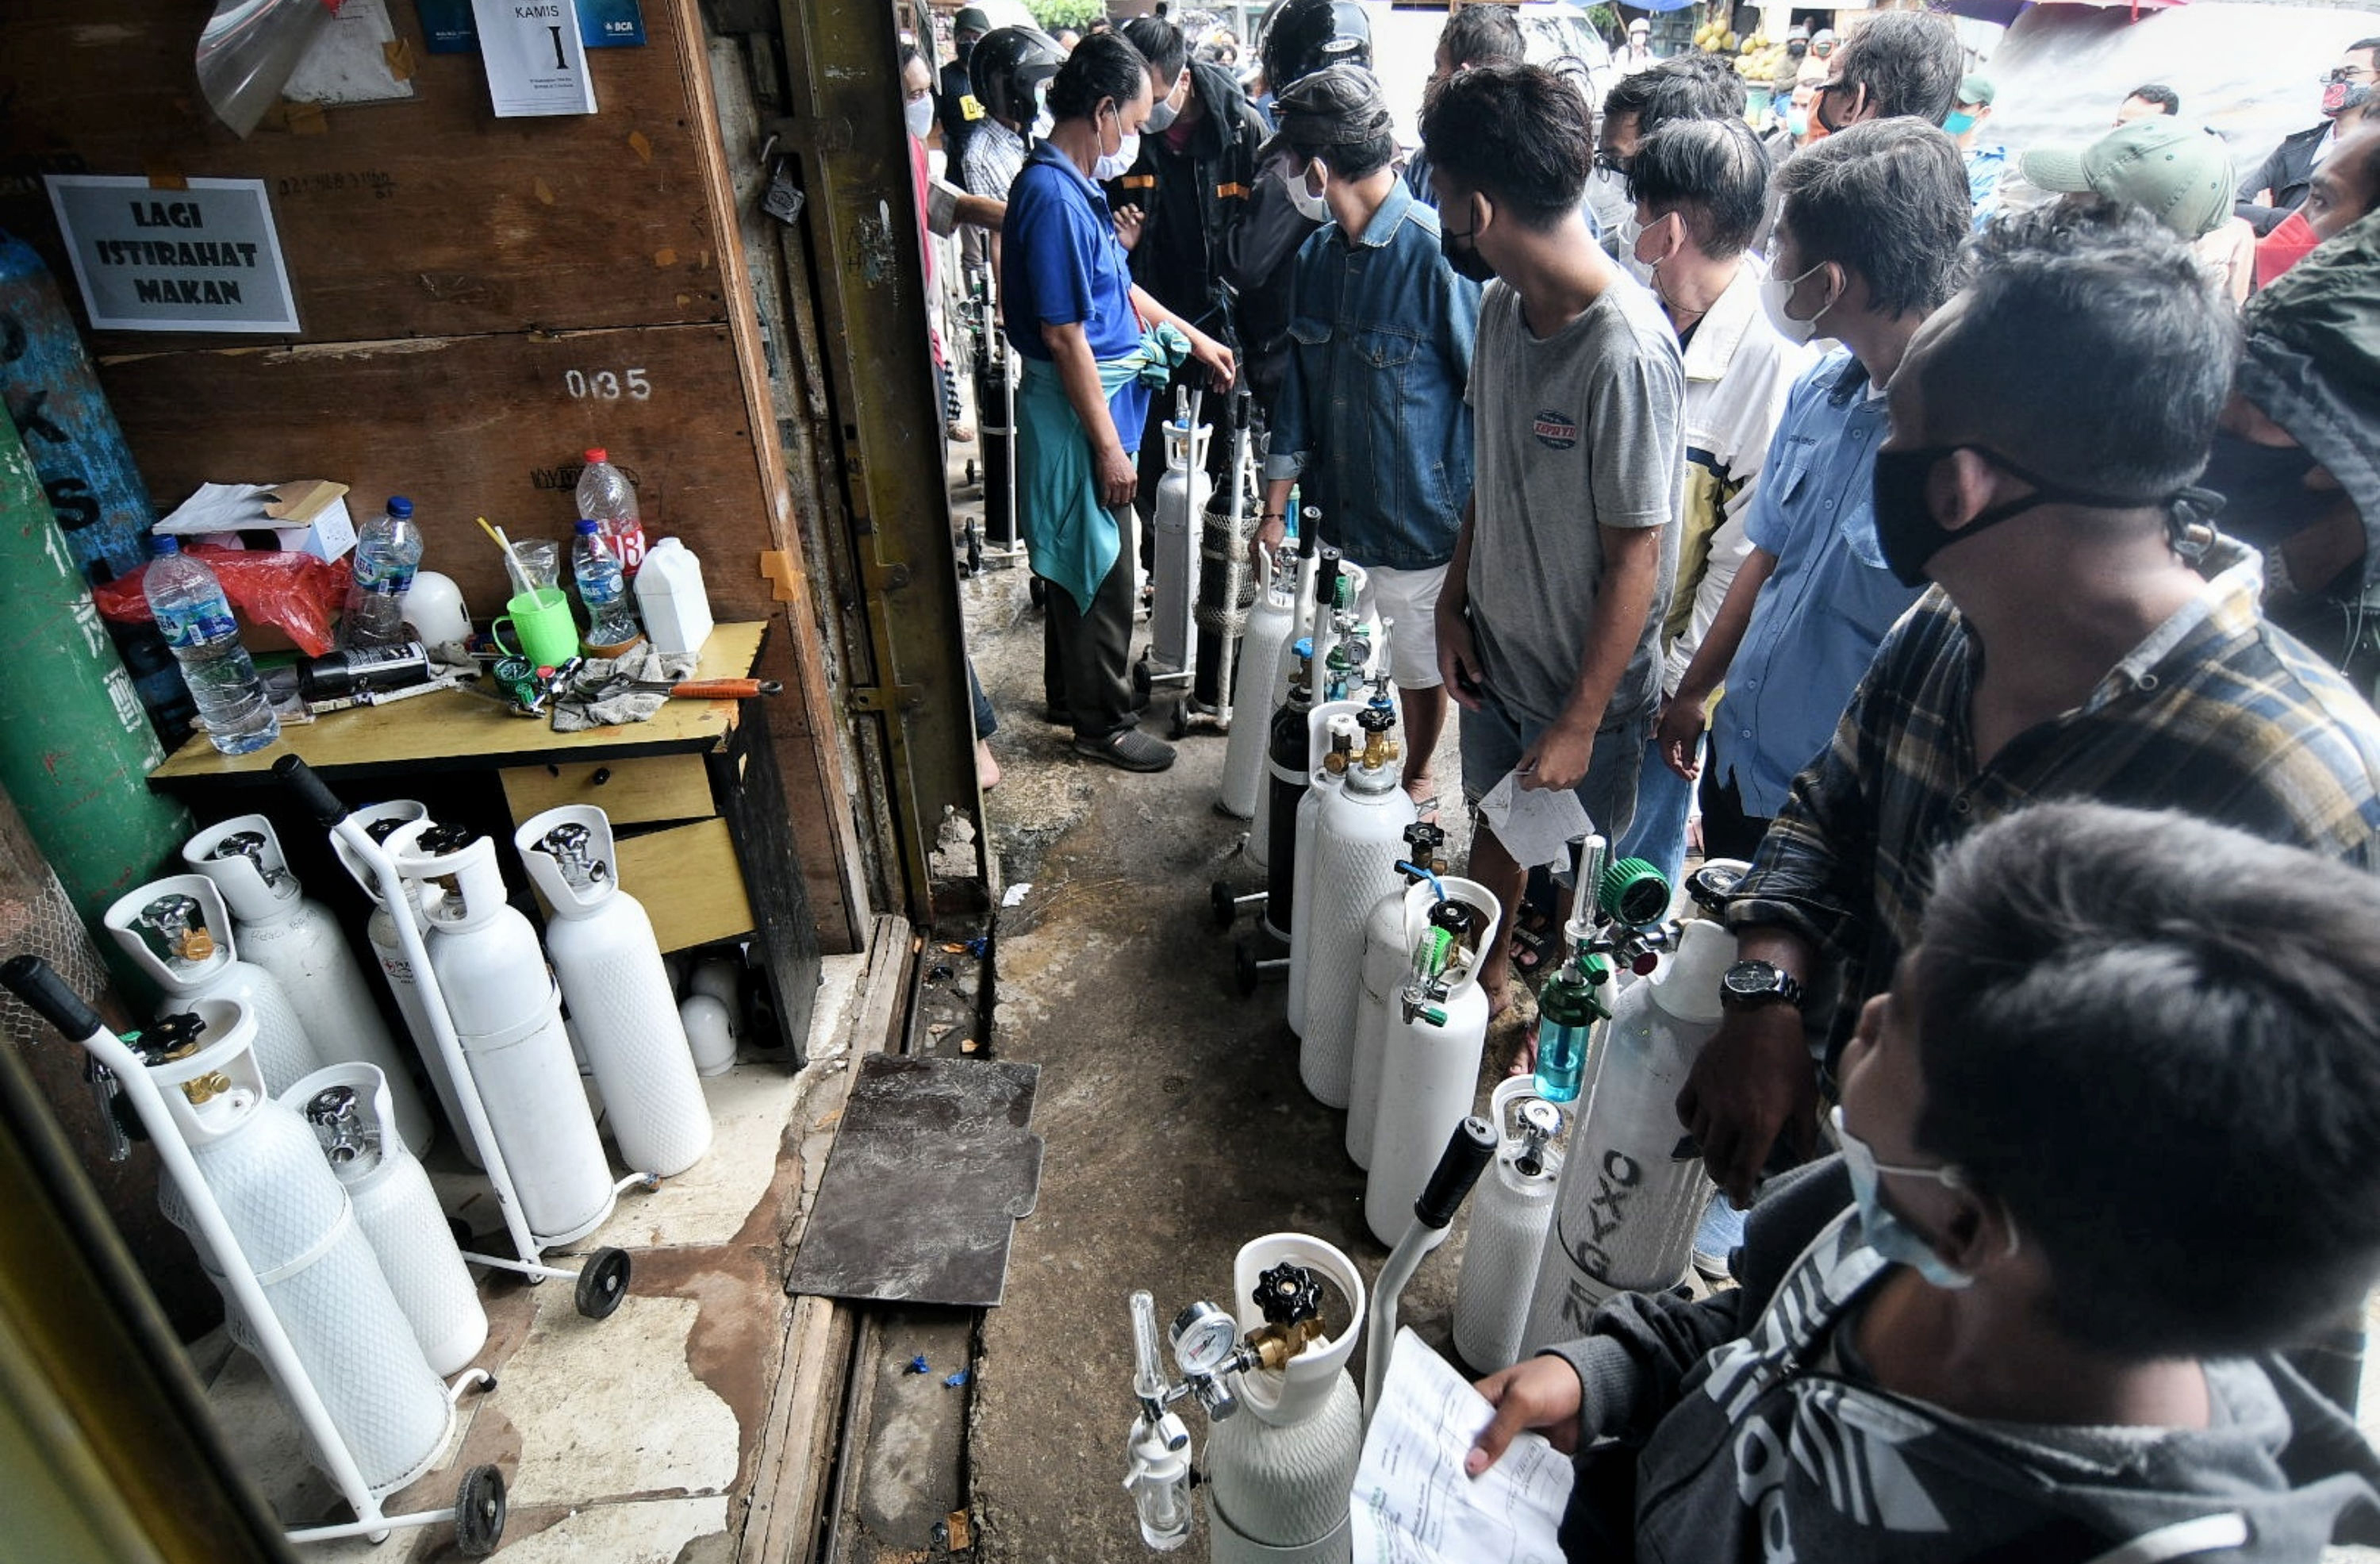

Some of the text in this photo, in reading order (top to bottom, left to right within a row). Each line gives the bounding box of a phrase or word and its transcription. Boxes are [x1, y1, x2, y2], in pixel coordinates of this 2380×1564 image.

[515, 6, 559, 18] KAMIS
[615, 21, 633, 32] BCA
[130, 202, 203, 229] LAGI
[96, 240, 258, 267] ISTIRAHAT
[134, 279, 242, 305] MAKAN
